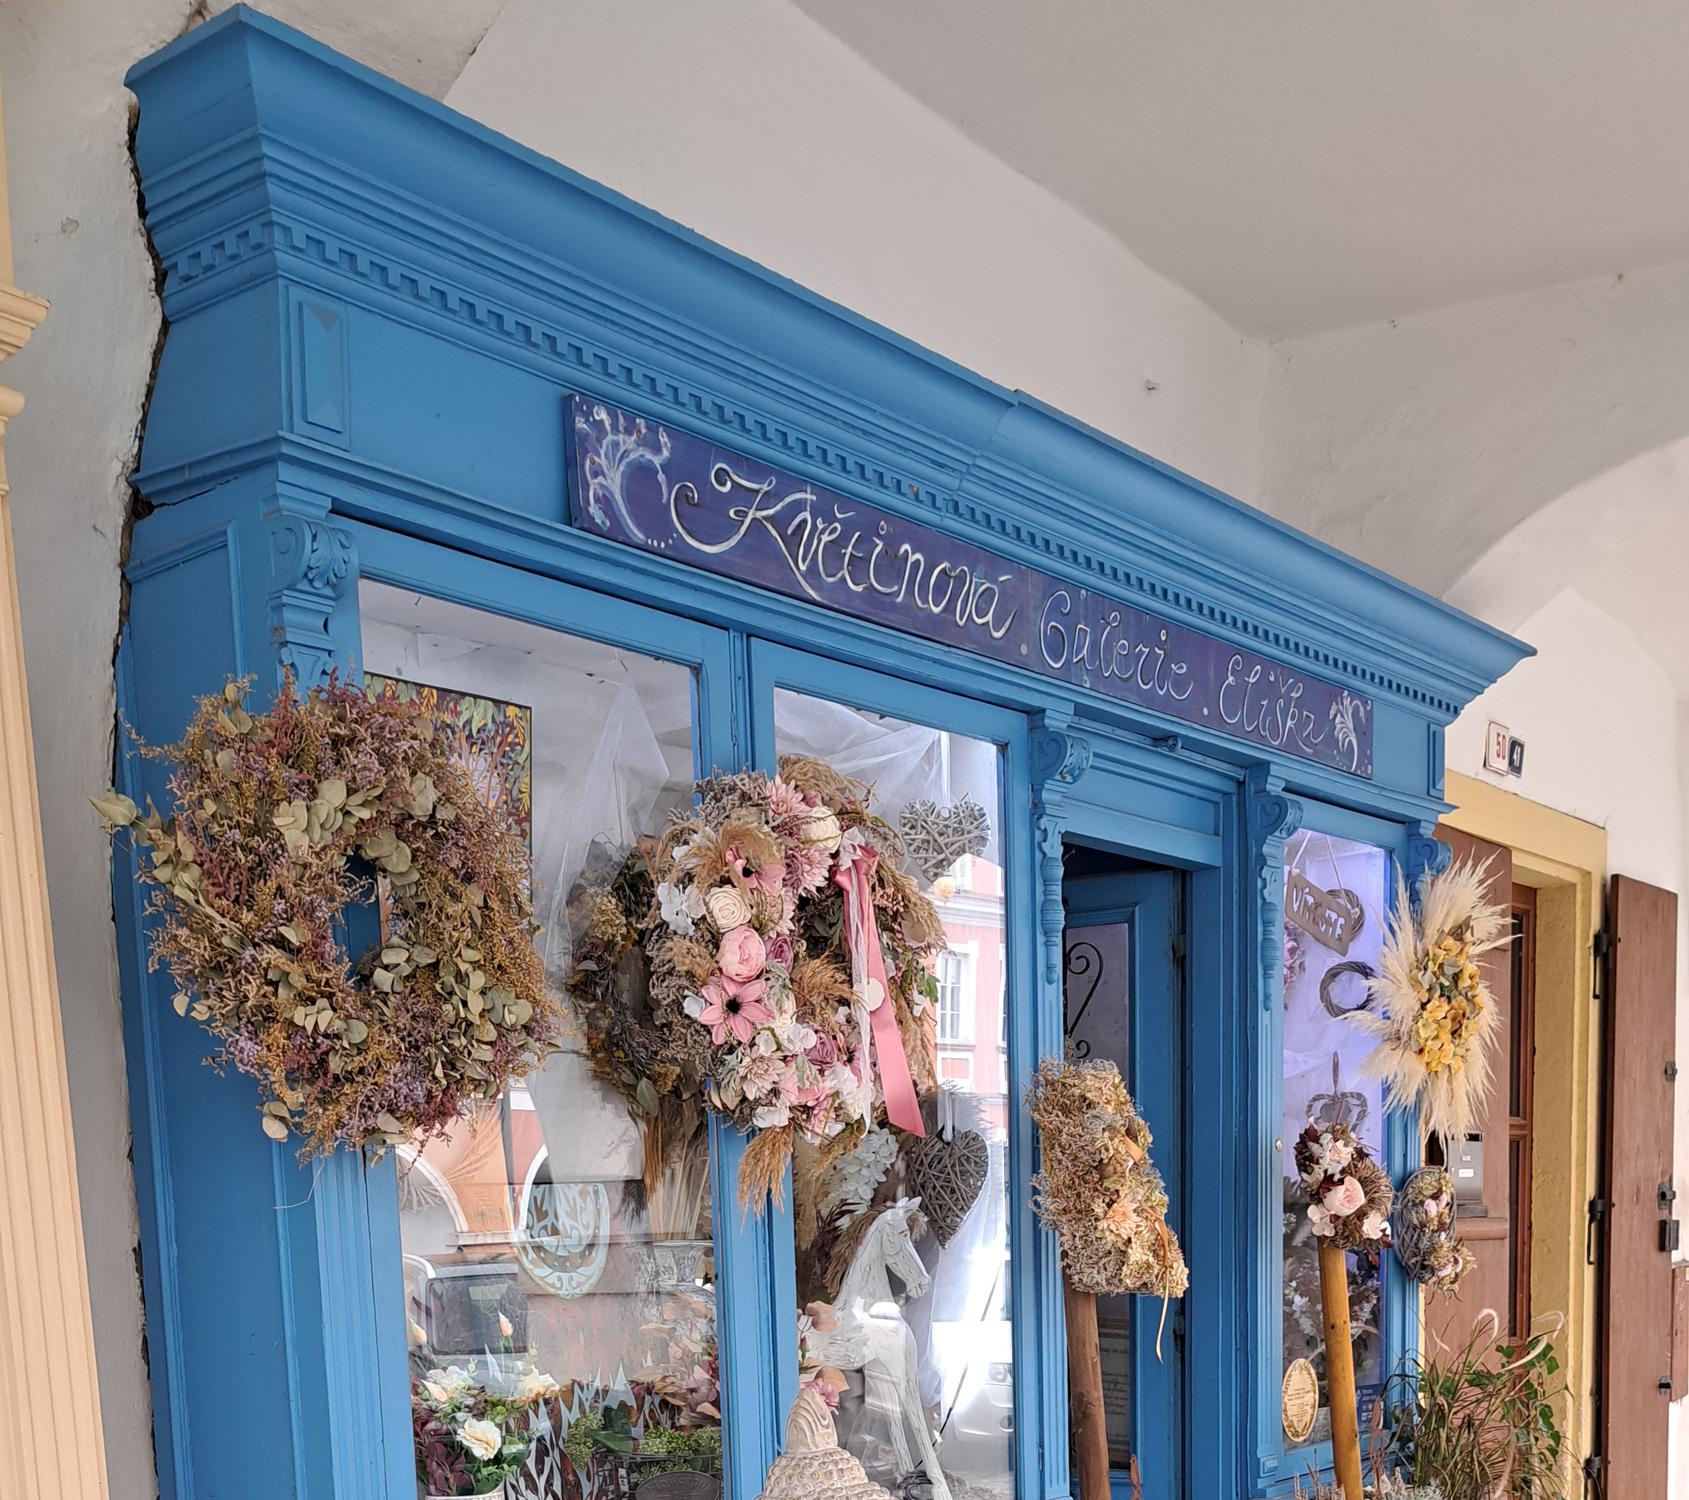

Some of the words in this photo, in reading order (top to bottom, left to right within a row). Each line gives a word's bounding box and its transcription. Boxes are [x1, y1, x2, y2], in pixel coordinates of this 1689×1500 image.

[670, 461, 1016, 641] Květinová
[1038, 590, 1194, 701] Galerie
[1218, 654, 1329, 753] Eliška
[1496, 732, 1507, 761] 50
[1513, 745, 1522, 768] 41
